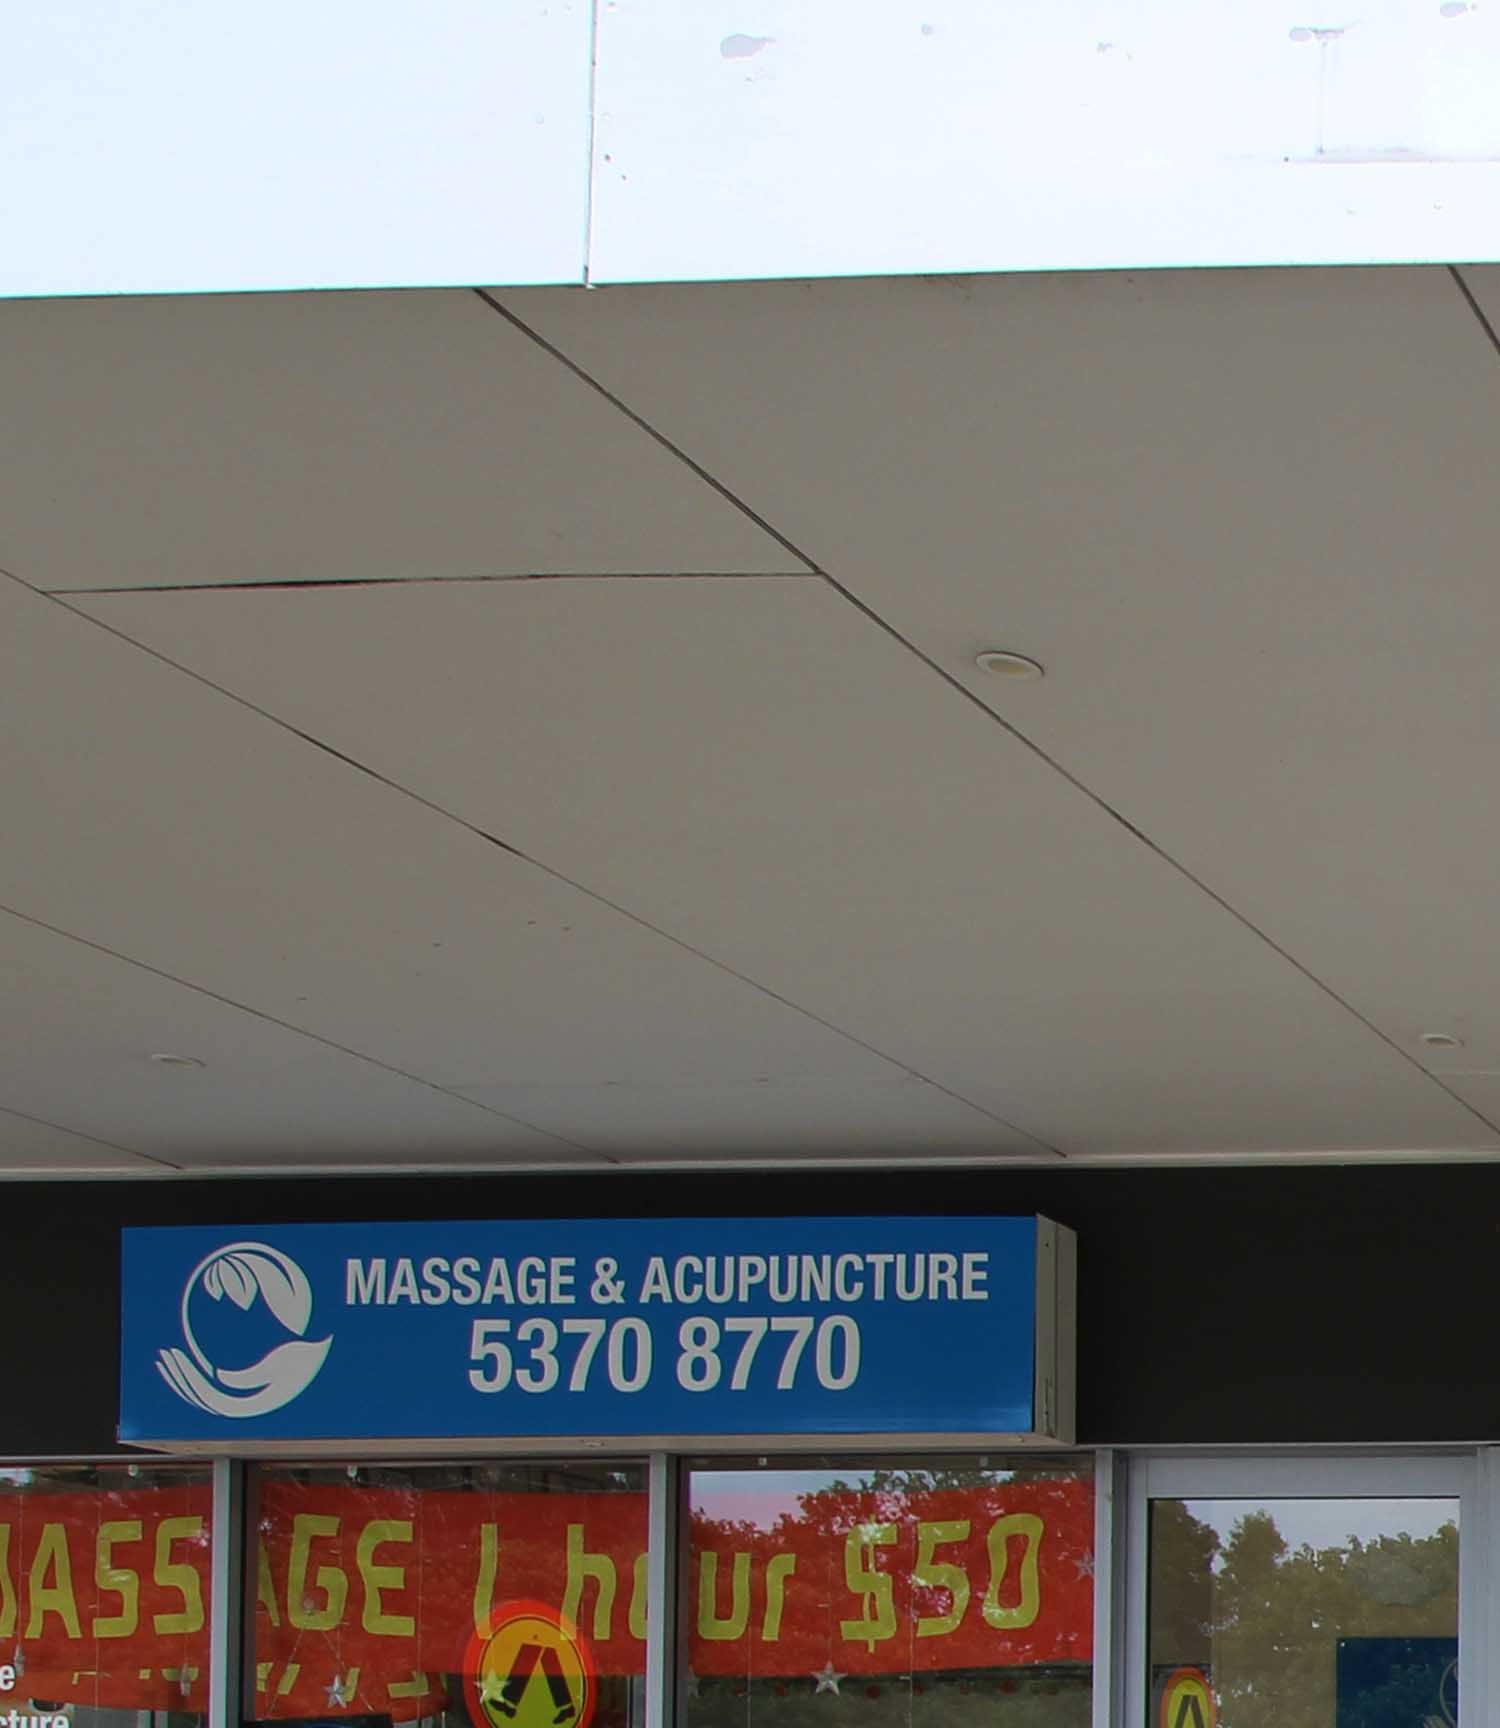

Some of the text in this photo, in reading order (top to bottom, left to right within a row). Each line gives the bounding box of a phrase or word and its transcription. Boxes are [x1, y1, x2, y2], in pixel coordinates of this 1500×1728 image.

[346, 1252, 990, 1305] MASSAGE & ACUPUNCTURE
[468, 1315, 862, 1393] 5370 8770
[840, 1513, 1045, 1654] $50
